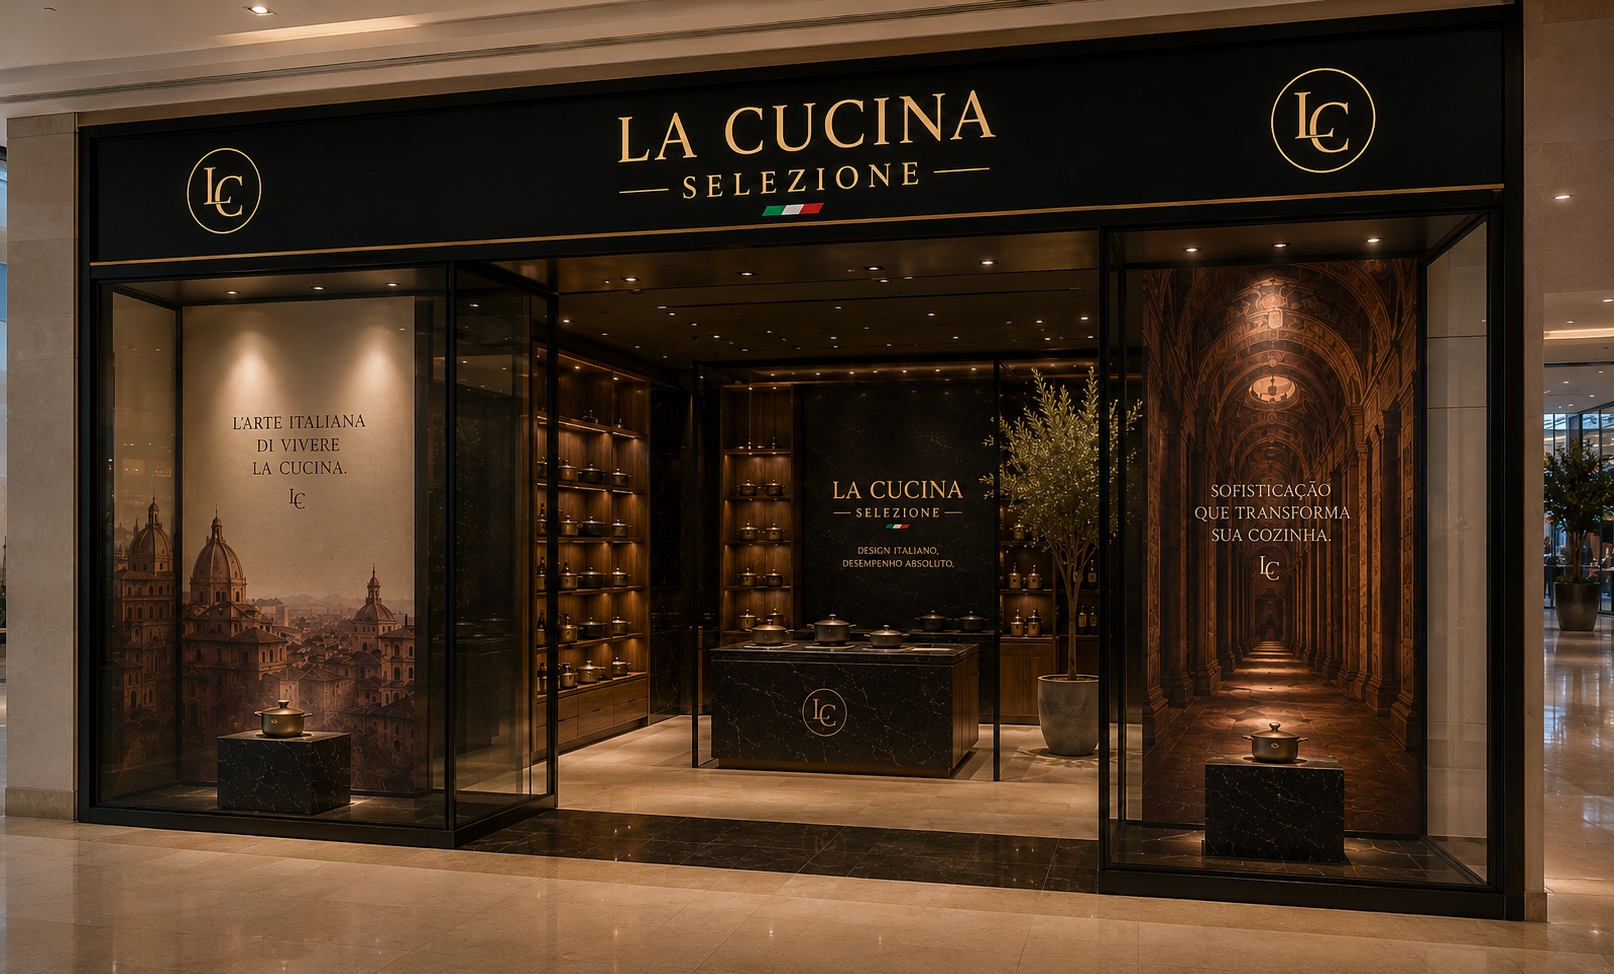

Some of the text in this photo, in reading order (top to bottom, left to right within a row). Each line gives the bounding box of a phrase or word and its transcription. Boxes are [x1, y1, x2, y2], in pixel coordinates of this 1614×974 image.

[617, 89, 996, 164] LA CUCINA
[682, 161, 920, 199] SELEZIONE
[232, 414, 366, 430] L'ARTE ITALIANA
[257, 437, 340, 453] DI VIVERE
[252, 460, 348, 476] LA CUCINA.
[832, 480, 964, 500] LA CUCINA
[1210, 480, 1332, 501] SOFISTICAÇÃO
[855, 507, 940, 519] SELEZIONE
[1194, 505, 1351, 523] QUE TRANSFORMA
[1211, 528, 1333, 543] SUA COZINHA.
[857, 546, 891, 556] DESIGN
[842, 559, 903, 569] DESEMPENHO
